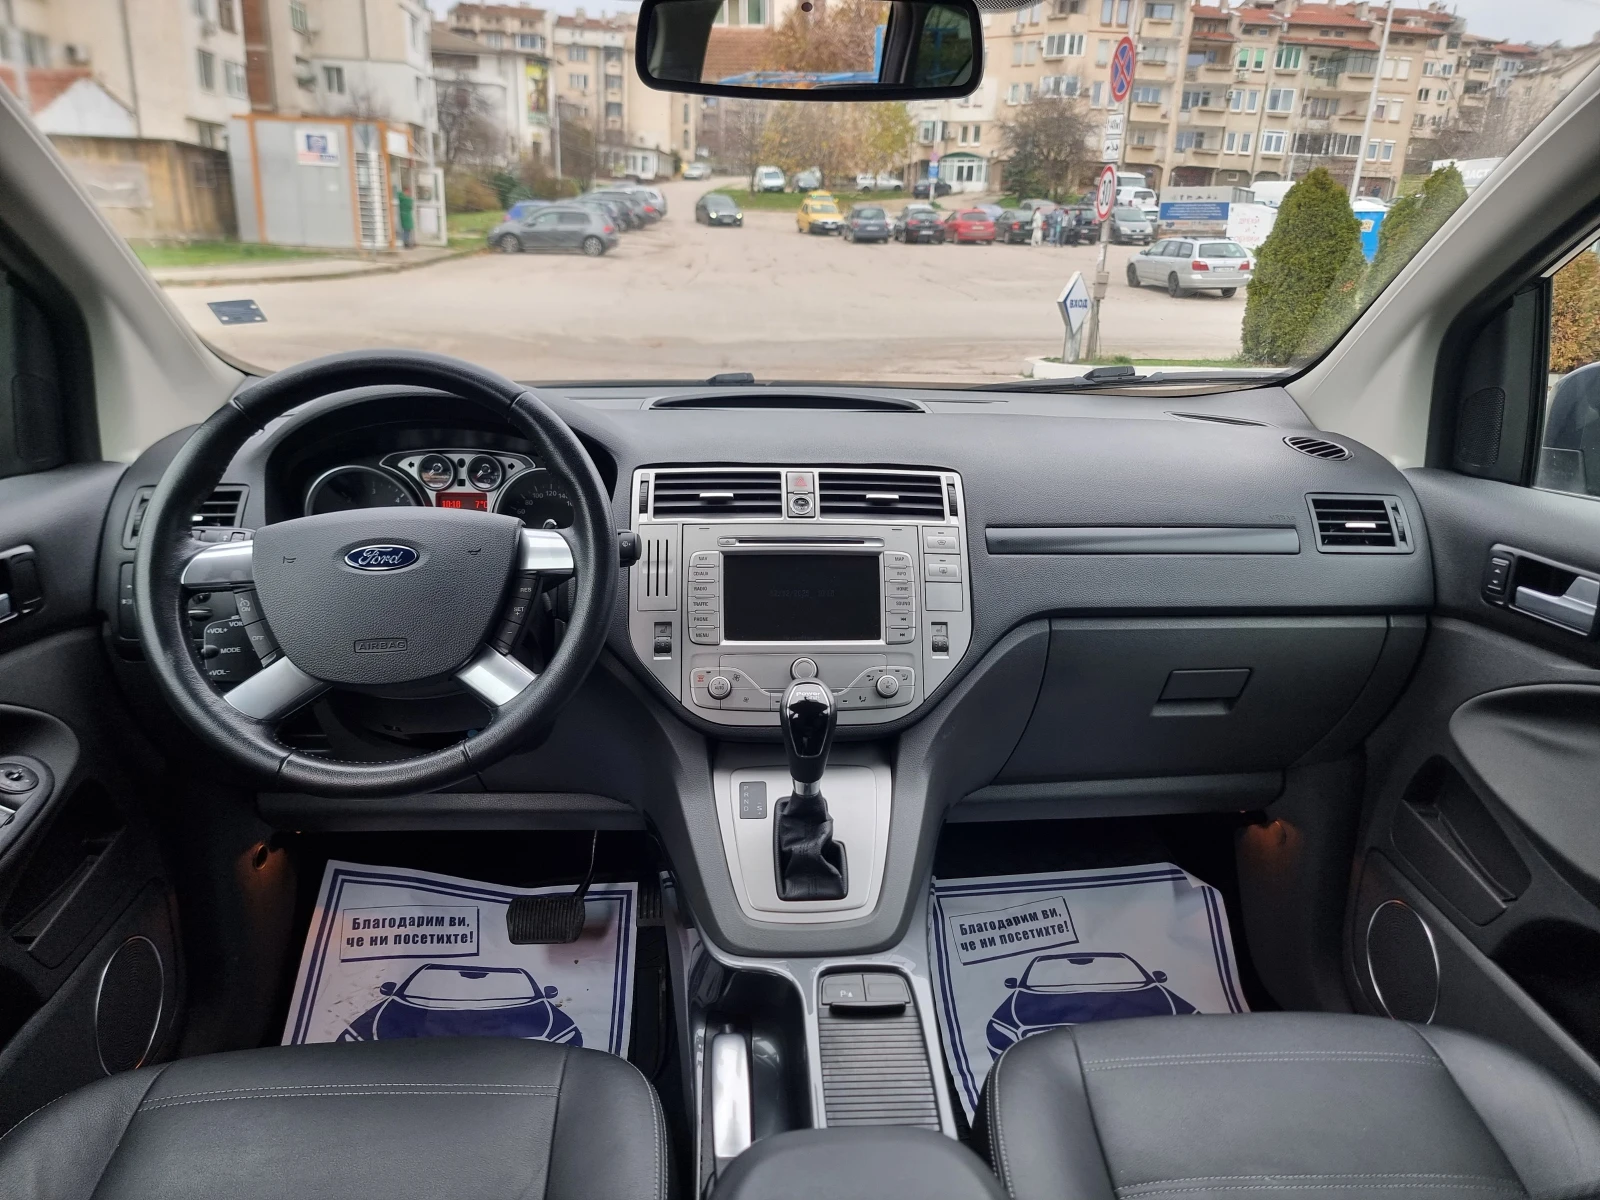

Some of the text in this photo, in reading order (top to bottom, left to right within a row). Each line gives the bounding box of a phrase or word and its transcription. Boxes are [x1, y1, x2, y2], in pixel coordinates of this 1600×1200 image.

[1100, 179, 1112, 206] 30
[358, 547, 403, 565] Ford
[220, 646, 242, 654] MODE
[358, 641, 406, 651] AIRBAG
[351, 915, 470, 931] Благодарим ви,
[959, 907, 1062, 936] Благодарим ви,
[346, 931, 474, 947] че ни посетихте!
[960, 920, 1070, 952] че ни посетихте!
